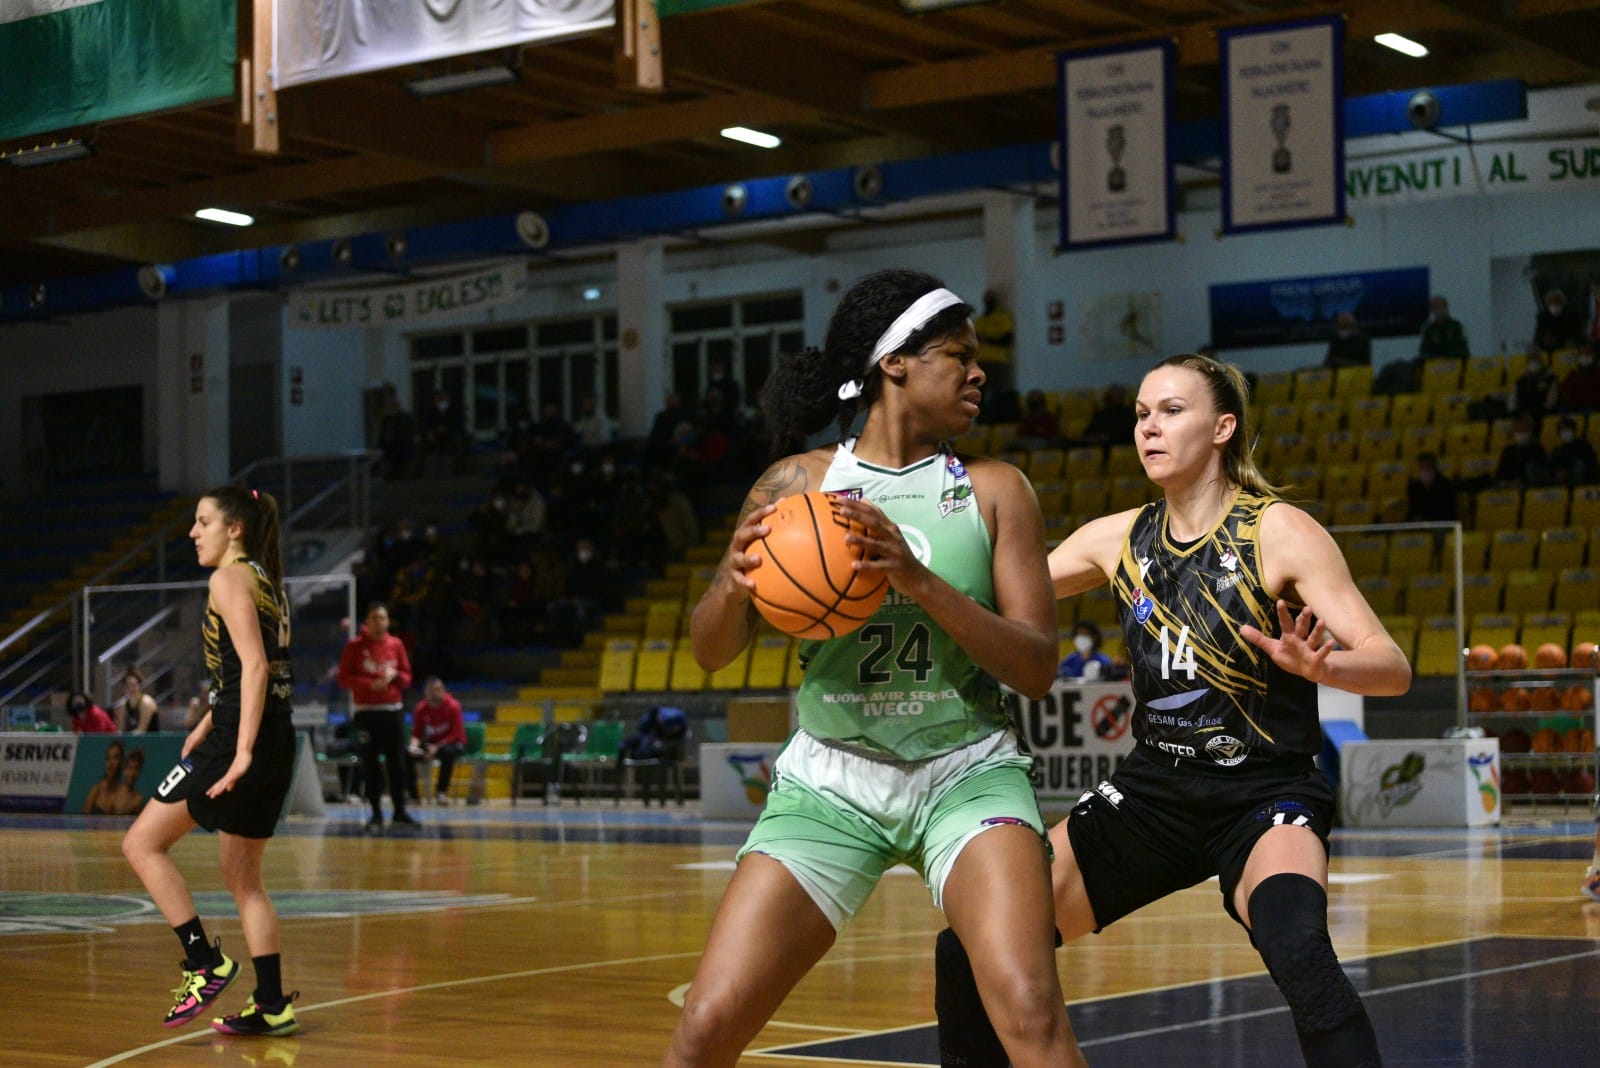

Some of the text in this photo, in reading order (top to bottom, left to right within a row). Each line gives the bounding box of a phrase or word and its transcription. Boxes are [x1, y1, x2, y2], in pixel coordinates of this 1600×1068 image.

[1488, 152, 1528, 183] AL
[1548, 146, 1600, 180] SUD
[857, 621, 934, 686] 24
[1160, 625, 1198, 680] 14
[822, 693, 866, 704] NUOVA
[871, 690, 905, 702] AVIR
[863, 701, 925, 718] IVECO
[1148, 713, 1175, 727] GESAM
[1177, 717, 1193, 728] Gas
[4, 743, 72, 761] SERVICE
[157, 763, 187, 797] 9
